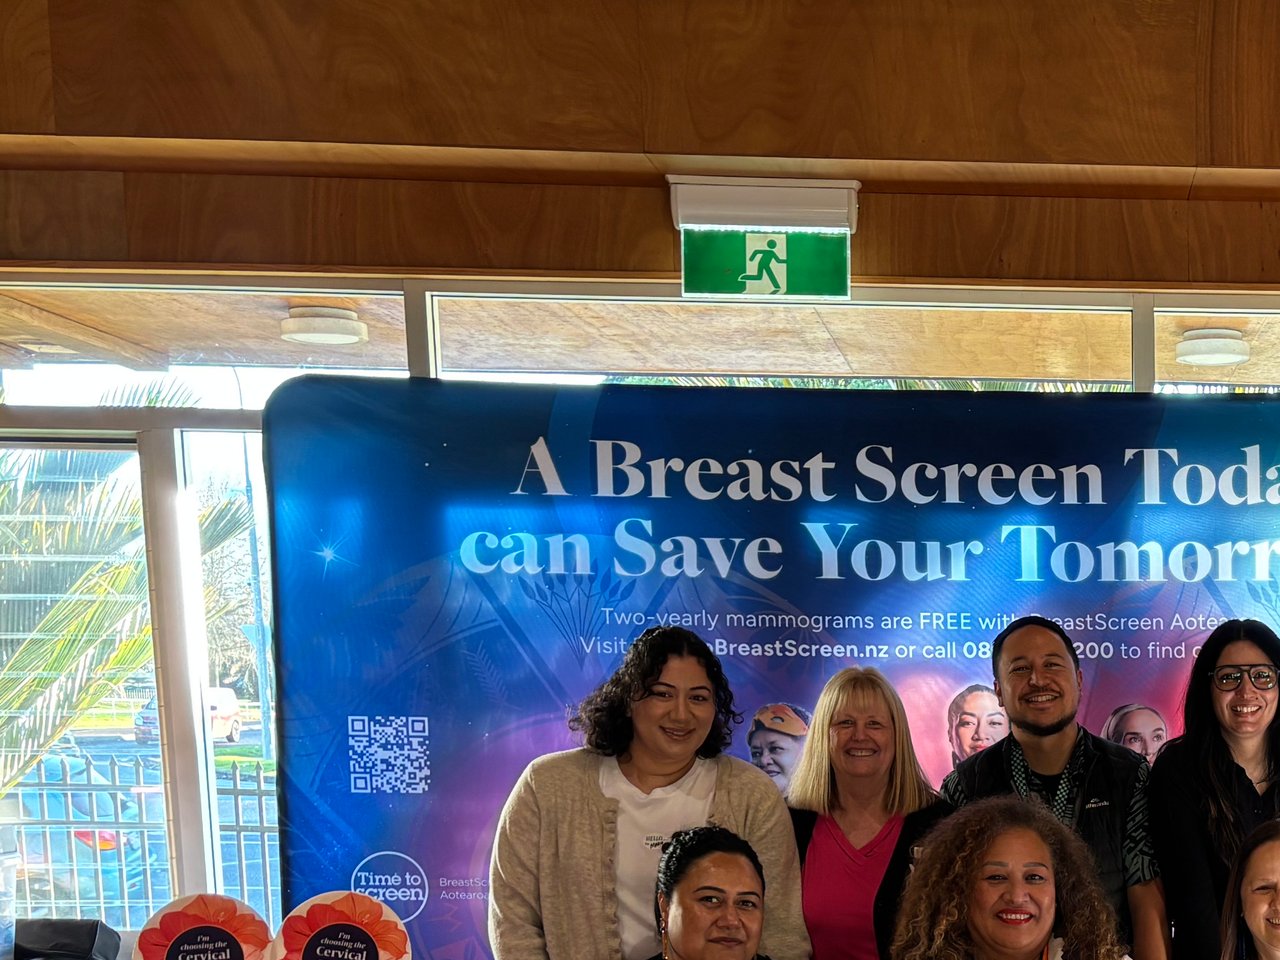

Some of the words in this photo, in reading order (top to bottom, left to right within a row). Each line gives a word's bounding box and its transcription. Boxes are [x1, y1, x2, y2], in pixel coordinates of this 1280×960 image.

[510, 436, 573, 496] A
[589, 439, 837, 502] Breast
[855, 444, 1106, 506] Screen
[460, 531, 595, 575] can
[613, 517, 783, 579] Save
[800, 521, 984, 583] Your
[601, 607, 719, 631] Two-yearly
[726, 611, 875, 633] mammograms
[880, 614, 913, 630] are
[920, 613, 972, 630] FREE
[579, 636, 627, 655] Visit
[895, 646, 916, 659] or
[922, 641, 956, 659] call
[1120, 644, 1141, 659] to
[1147, 642, 1185, 659] find
[357, 872, 402, 886] Time
[405, 872, 422, 886] to
[440, 878, 487, 887] BreastSc
[320, 937, 353, 948] choosing
[338, 932, 351, 940] I'm
[180, 942, 214, 951] choosing
[316, 946, 367, 960] Cervical
